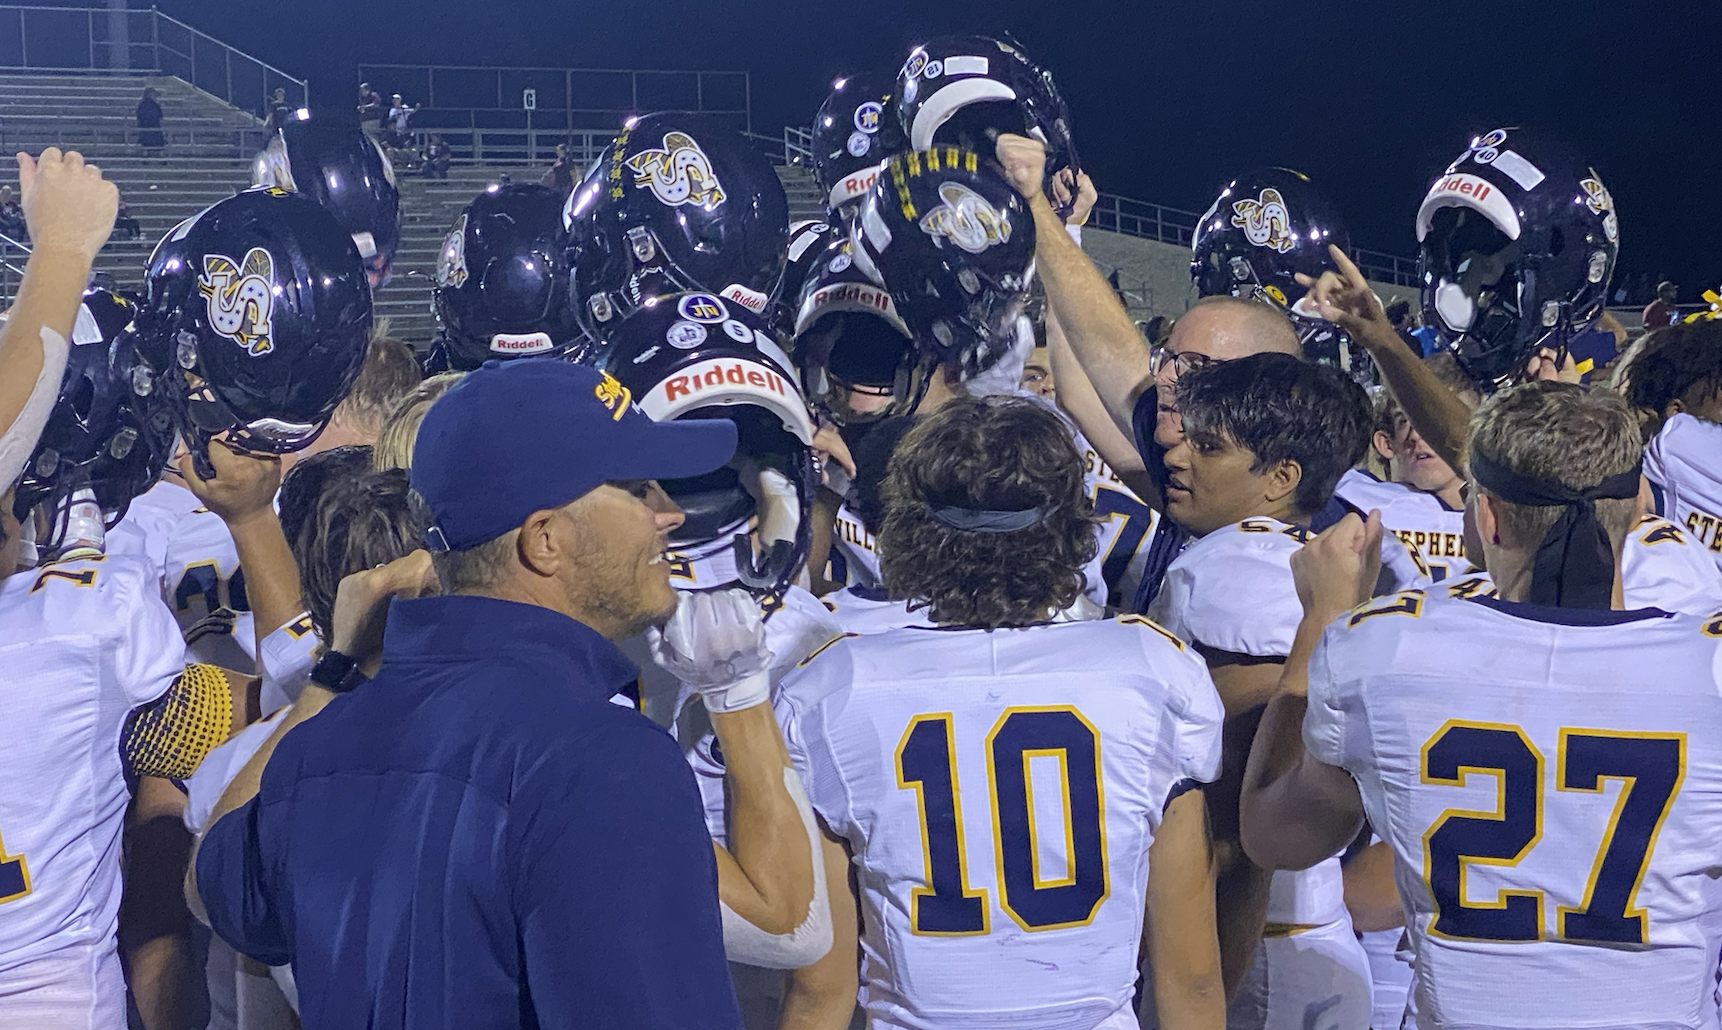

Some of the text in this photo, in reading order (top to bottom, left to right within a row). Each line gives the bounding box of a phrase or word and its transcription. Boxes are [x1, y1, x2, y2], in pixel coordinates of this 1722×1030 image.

[927, 63, 940, 75] 21
[525, 92, 534, 108] G
[1476, 150, 1495, 160] 40
[731, 288, 766, 309] Riddell
[814, 284, 889, 311] Riddell
[497, 338, 544, 350] Riddell
[664, 363, 785, 402] Riddell
[1391, 530, 1467, 558] EPHE
[893, 704, 1111, 937] 10
[1419, 718, 1688, 944] 27
